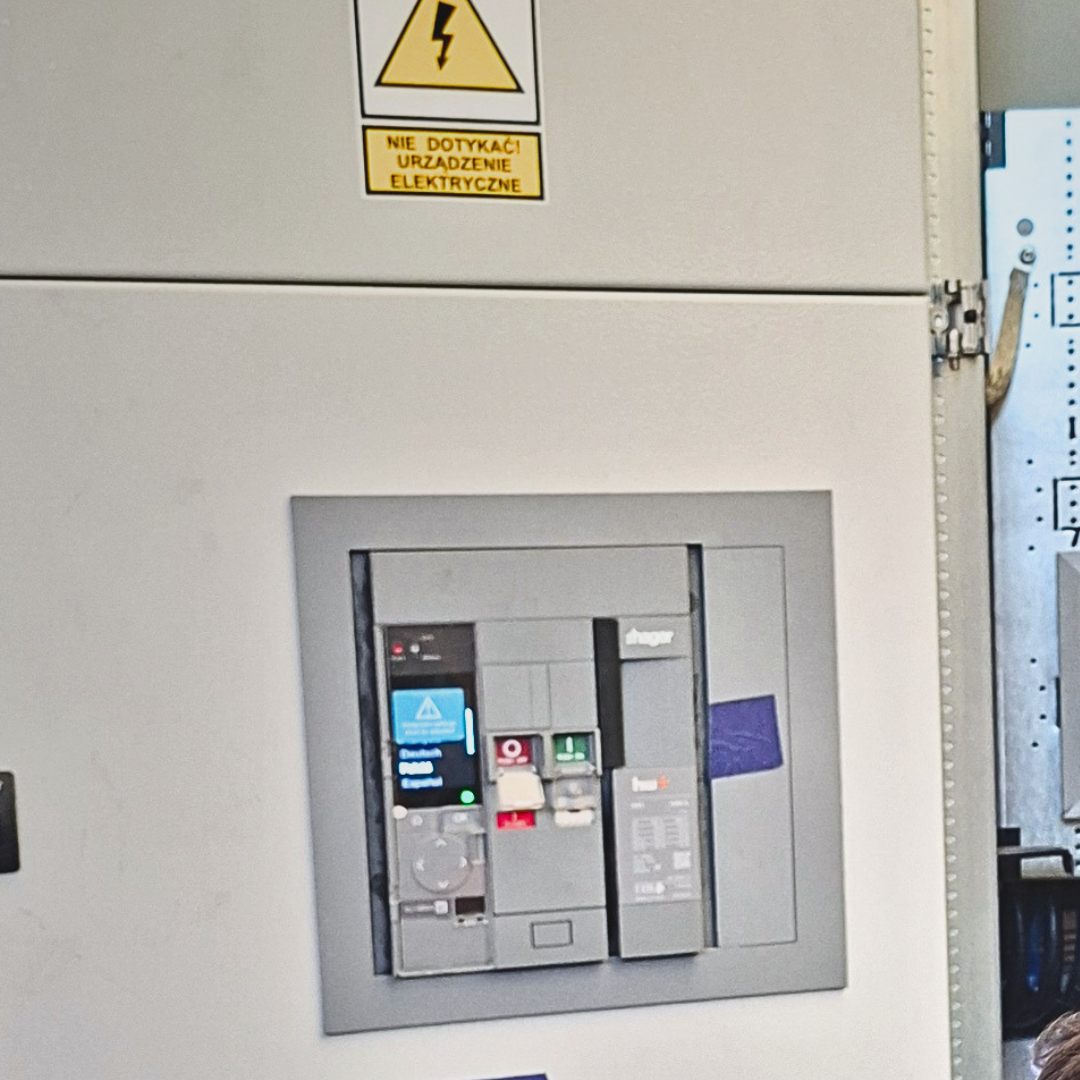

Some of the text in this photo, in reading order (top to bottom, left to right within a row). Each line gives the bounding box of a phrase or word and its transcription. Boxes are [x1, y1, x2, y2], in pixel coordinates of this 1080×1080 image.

[386, 135, 521, 155] NIE DOTYKAĆ!
[396, 154, 512, 174] URZĄDZENIE
[390, 174, 522, 193] ELEKTRYCZNE
